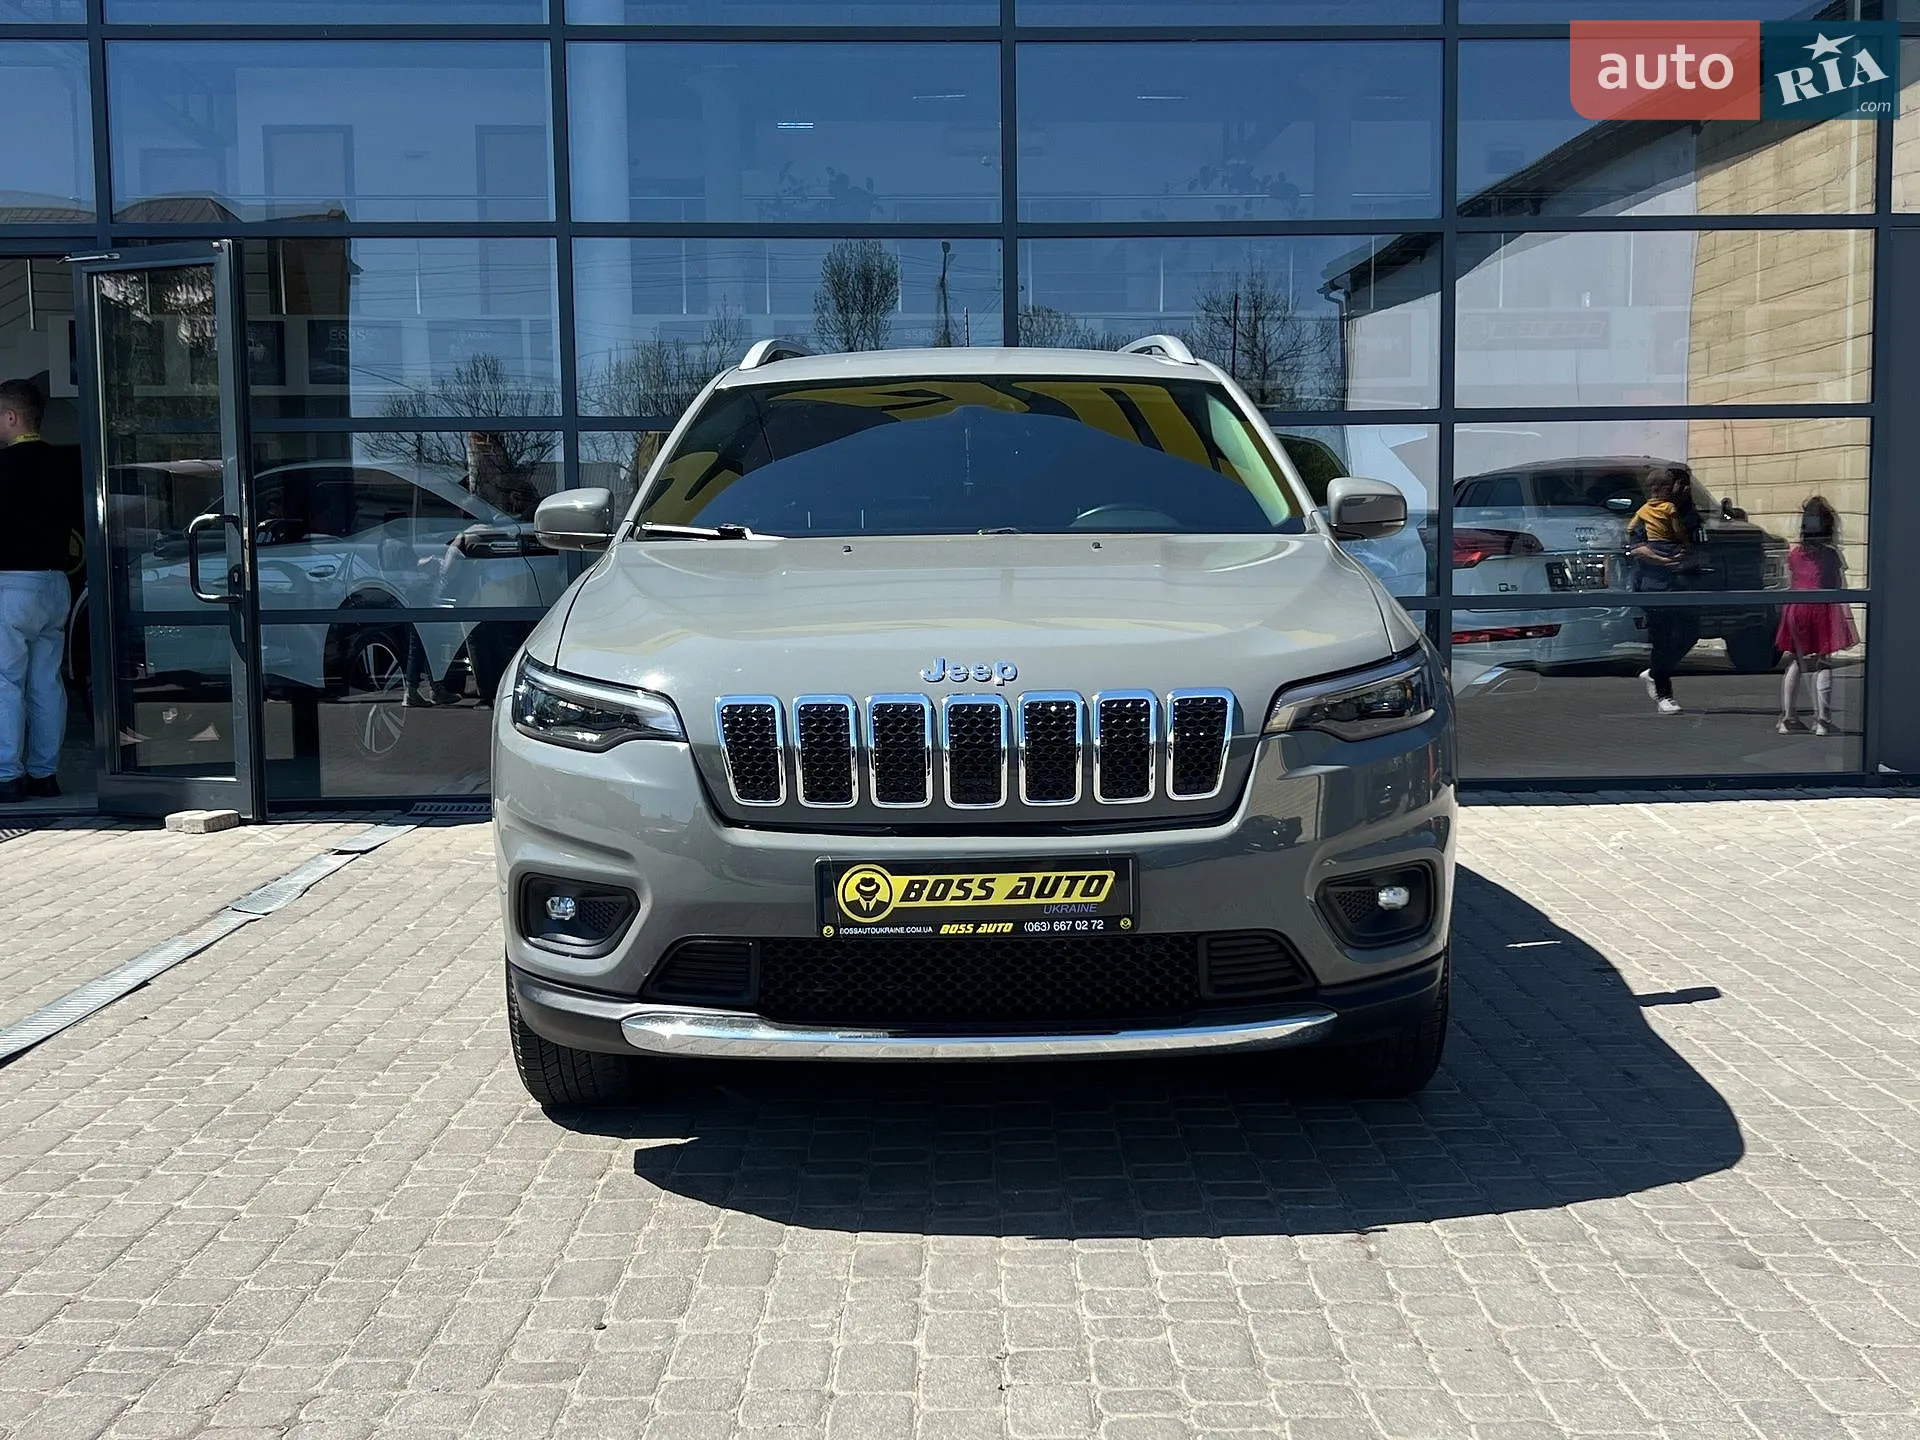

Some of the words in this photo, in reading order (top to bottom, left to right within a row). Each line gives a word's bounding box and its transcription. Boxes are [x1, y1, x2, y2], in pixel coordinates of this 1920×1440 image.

[920, 657, 1018, 686] Jeep
[899, 878, 997, 902] BOSS
[1004, 875, 1109, 900] AUTO
[1043, 903, 1098, 915] UKRAINE
[840, 926, 933, 935] BOSSAUTOUKRAINE.COM.UA
[939, 924, 974, 934] BOSS
[976, 922, 1014, 934] AUTO
[1023, 921, 1050, 933] (063)
[1053, 920, 1072, 931] 667
[1075, 920, 1088, 931] 02
[1090, 919, 1104, 930] 72
